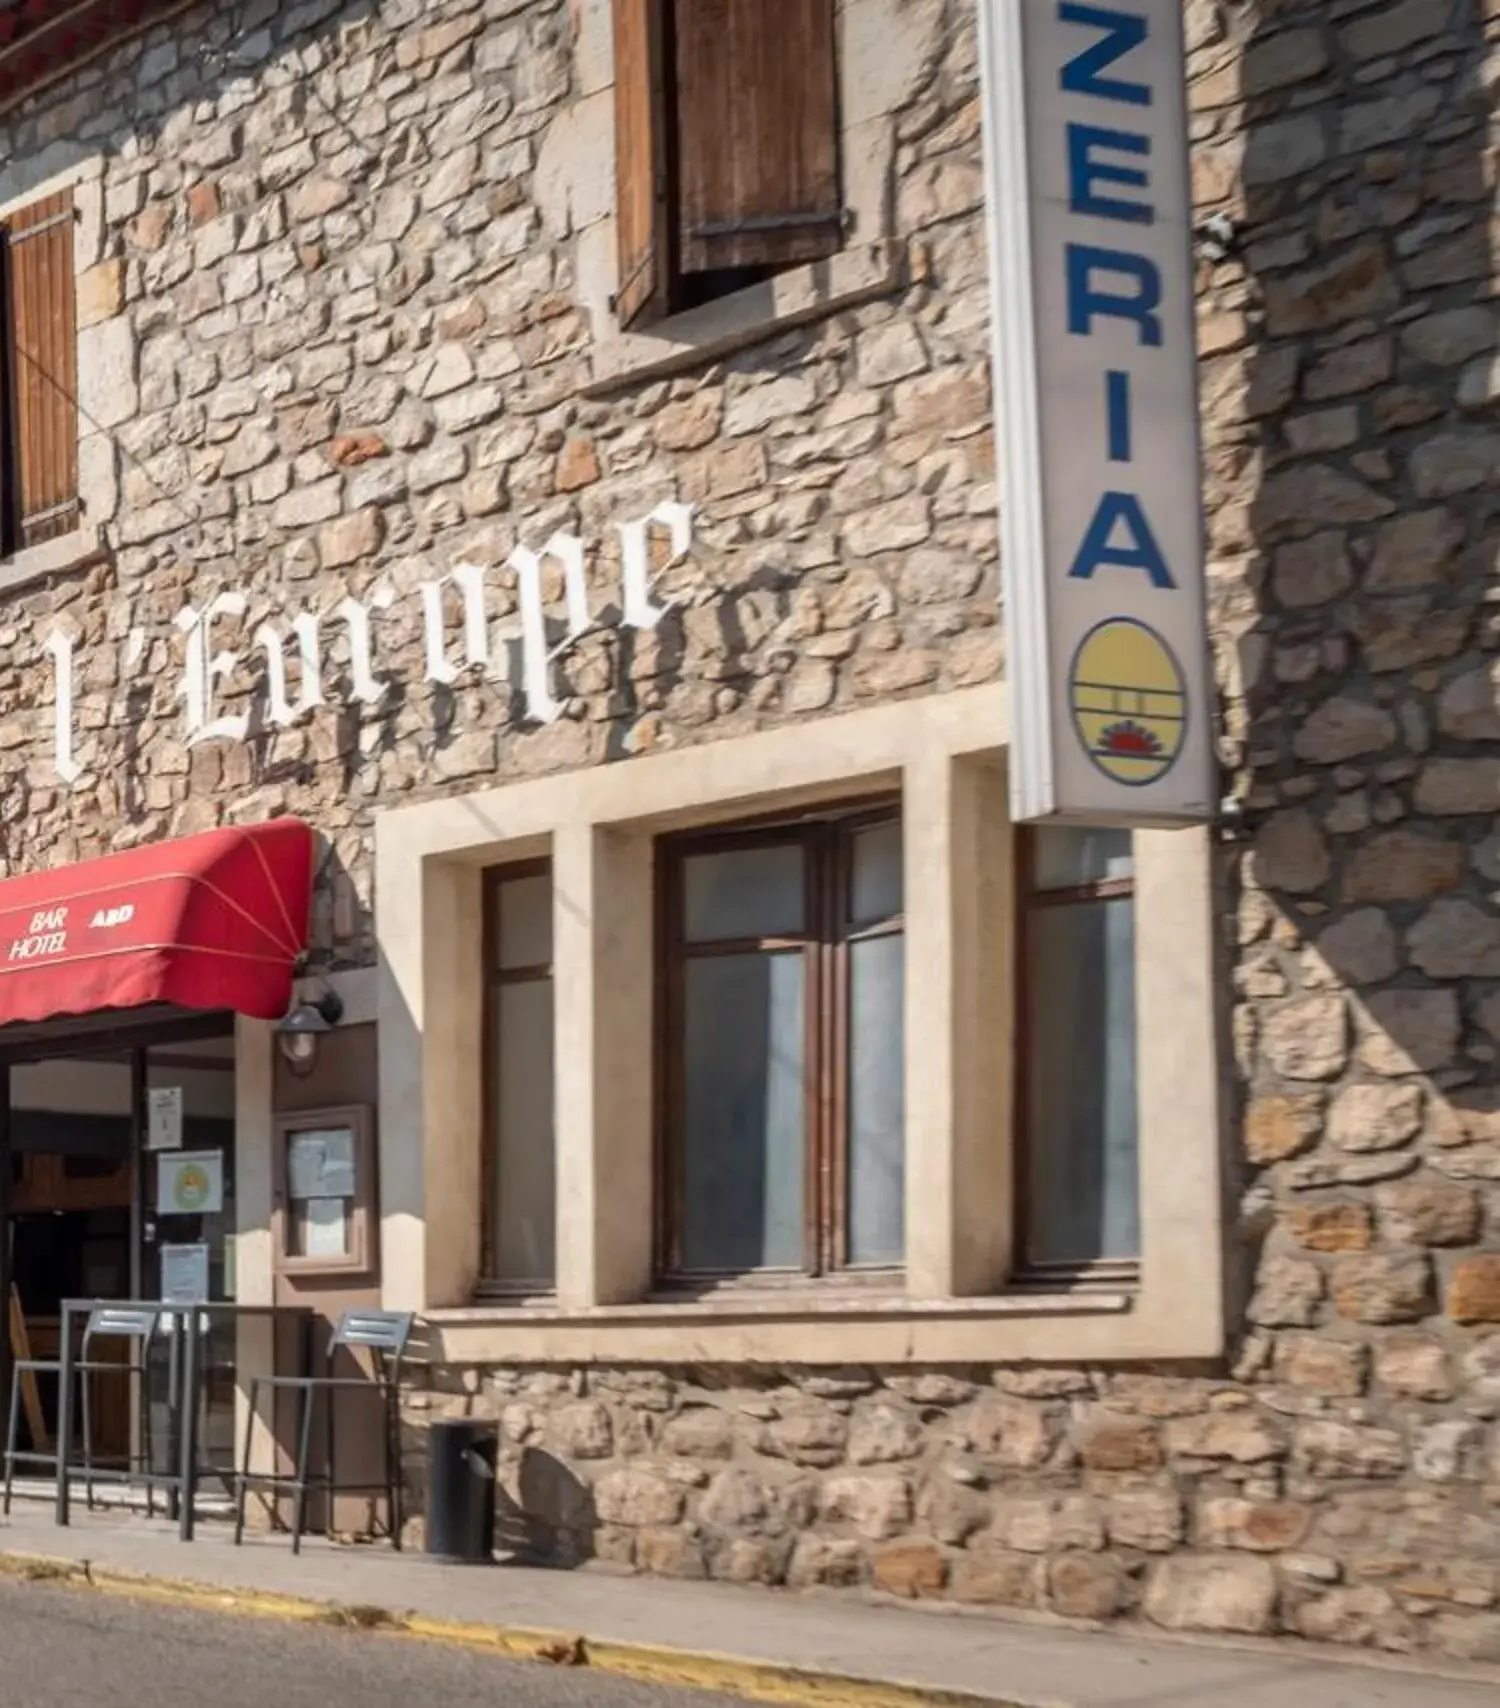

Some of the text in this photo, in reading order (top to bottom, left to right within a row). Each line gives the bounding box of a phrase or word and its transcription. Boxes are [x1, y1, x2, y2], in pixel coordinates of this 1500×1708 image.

[1057, 1, 1180, 591] ZERIA
[41, 500, 696, 788] l'Europe
[7, 931, 67, 961] HOTEL
[28, 906, 69, 935] BAR
